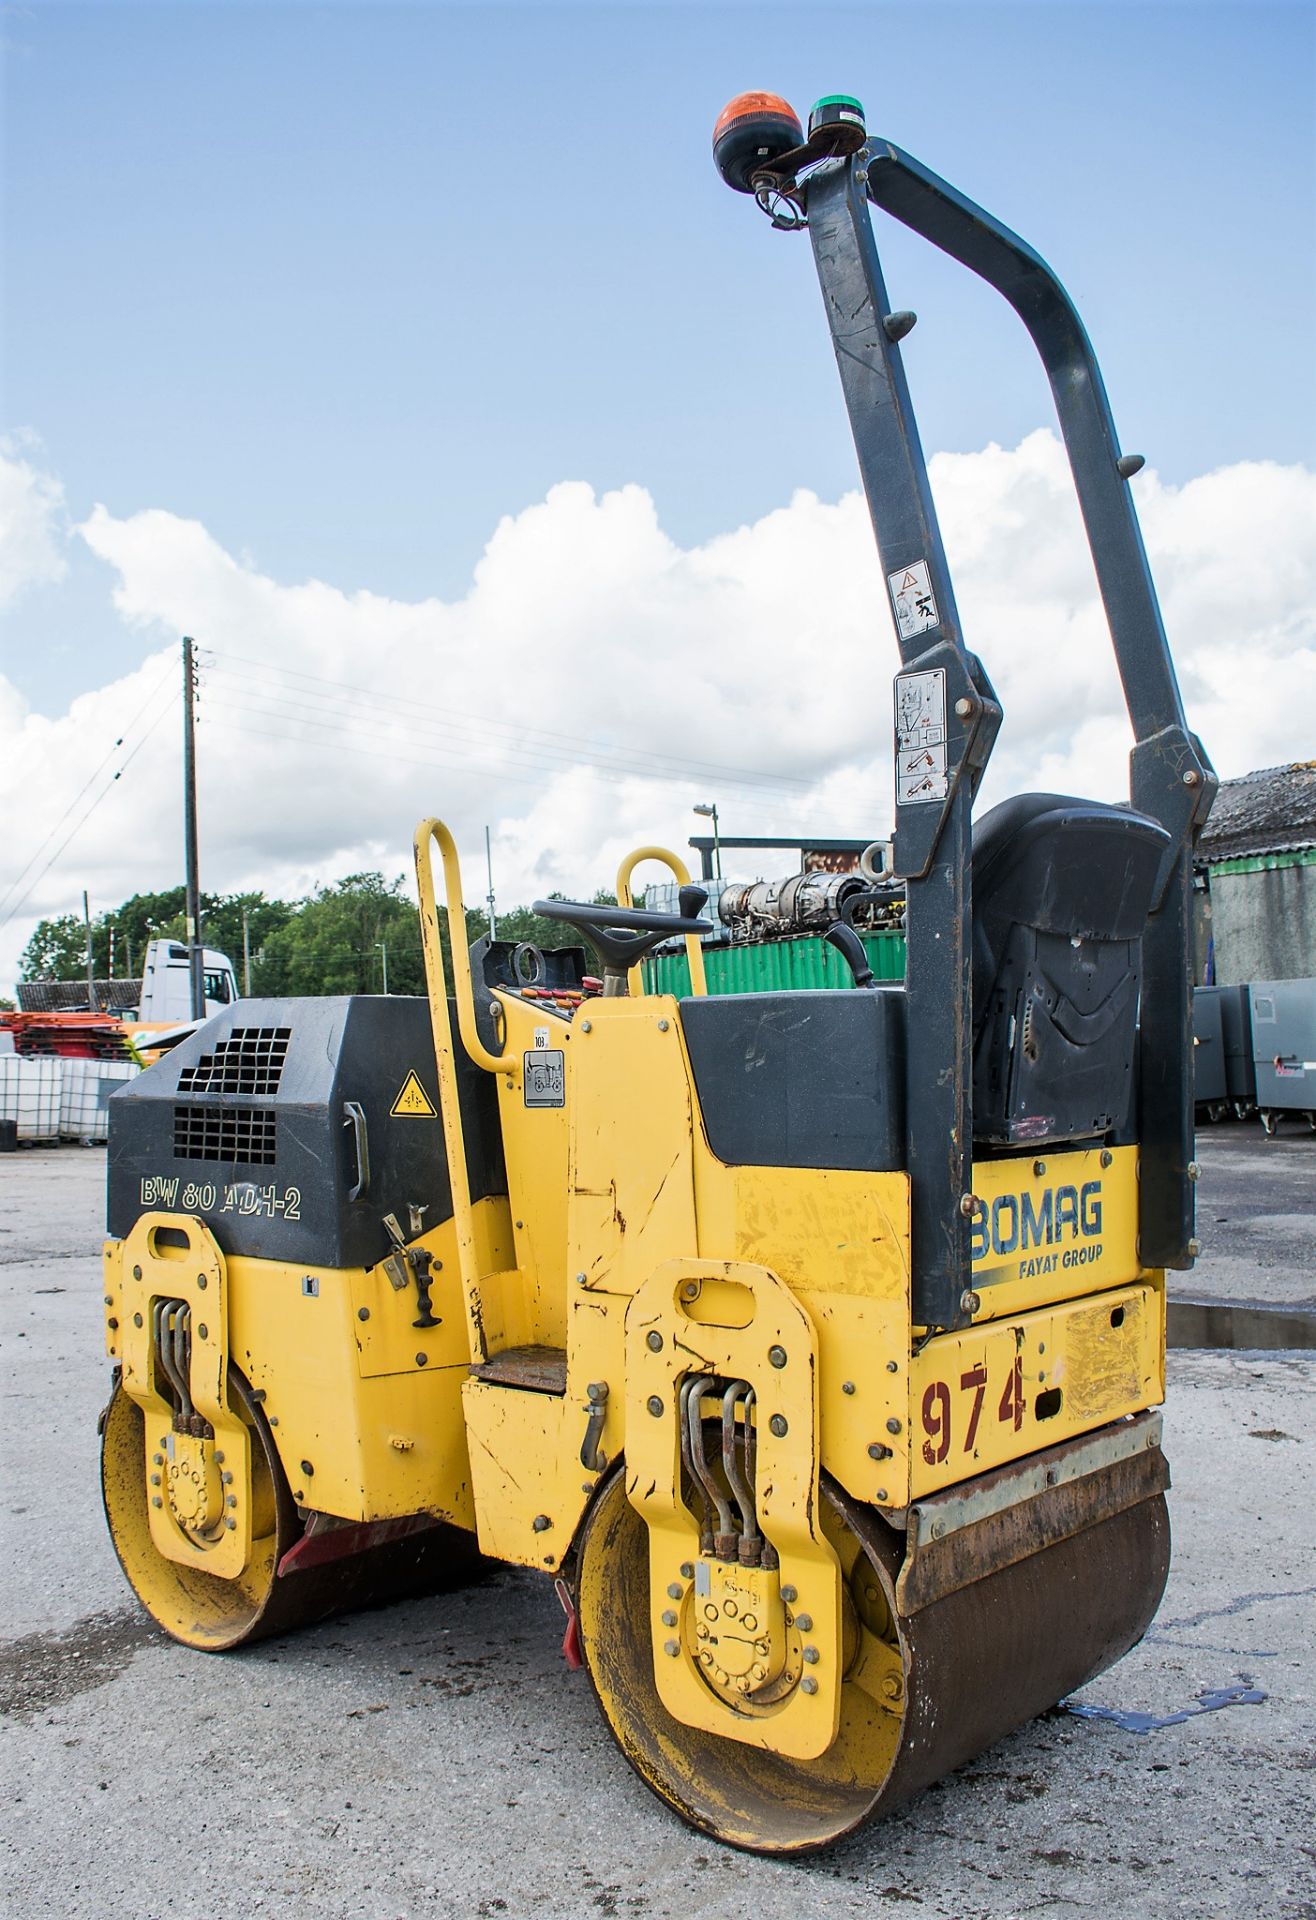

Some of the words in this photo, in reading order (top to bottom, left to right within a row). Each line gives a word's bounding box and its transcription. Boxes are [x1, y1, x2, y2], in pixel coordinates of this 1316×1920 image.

[140, 1176, 179, 1208] BW
[182, 1183, 216, 1211] 80
[219, 1184, 301, 1220] ADH-2
[971, 1181, 1102, 1260] BOMAG
[1019, 1253, 1058, 1279] FAYAT
[1062, 1244, 1103, 1269] GROUP
[921, 1355, 1026, 1466] 974
